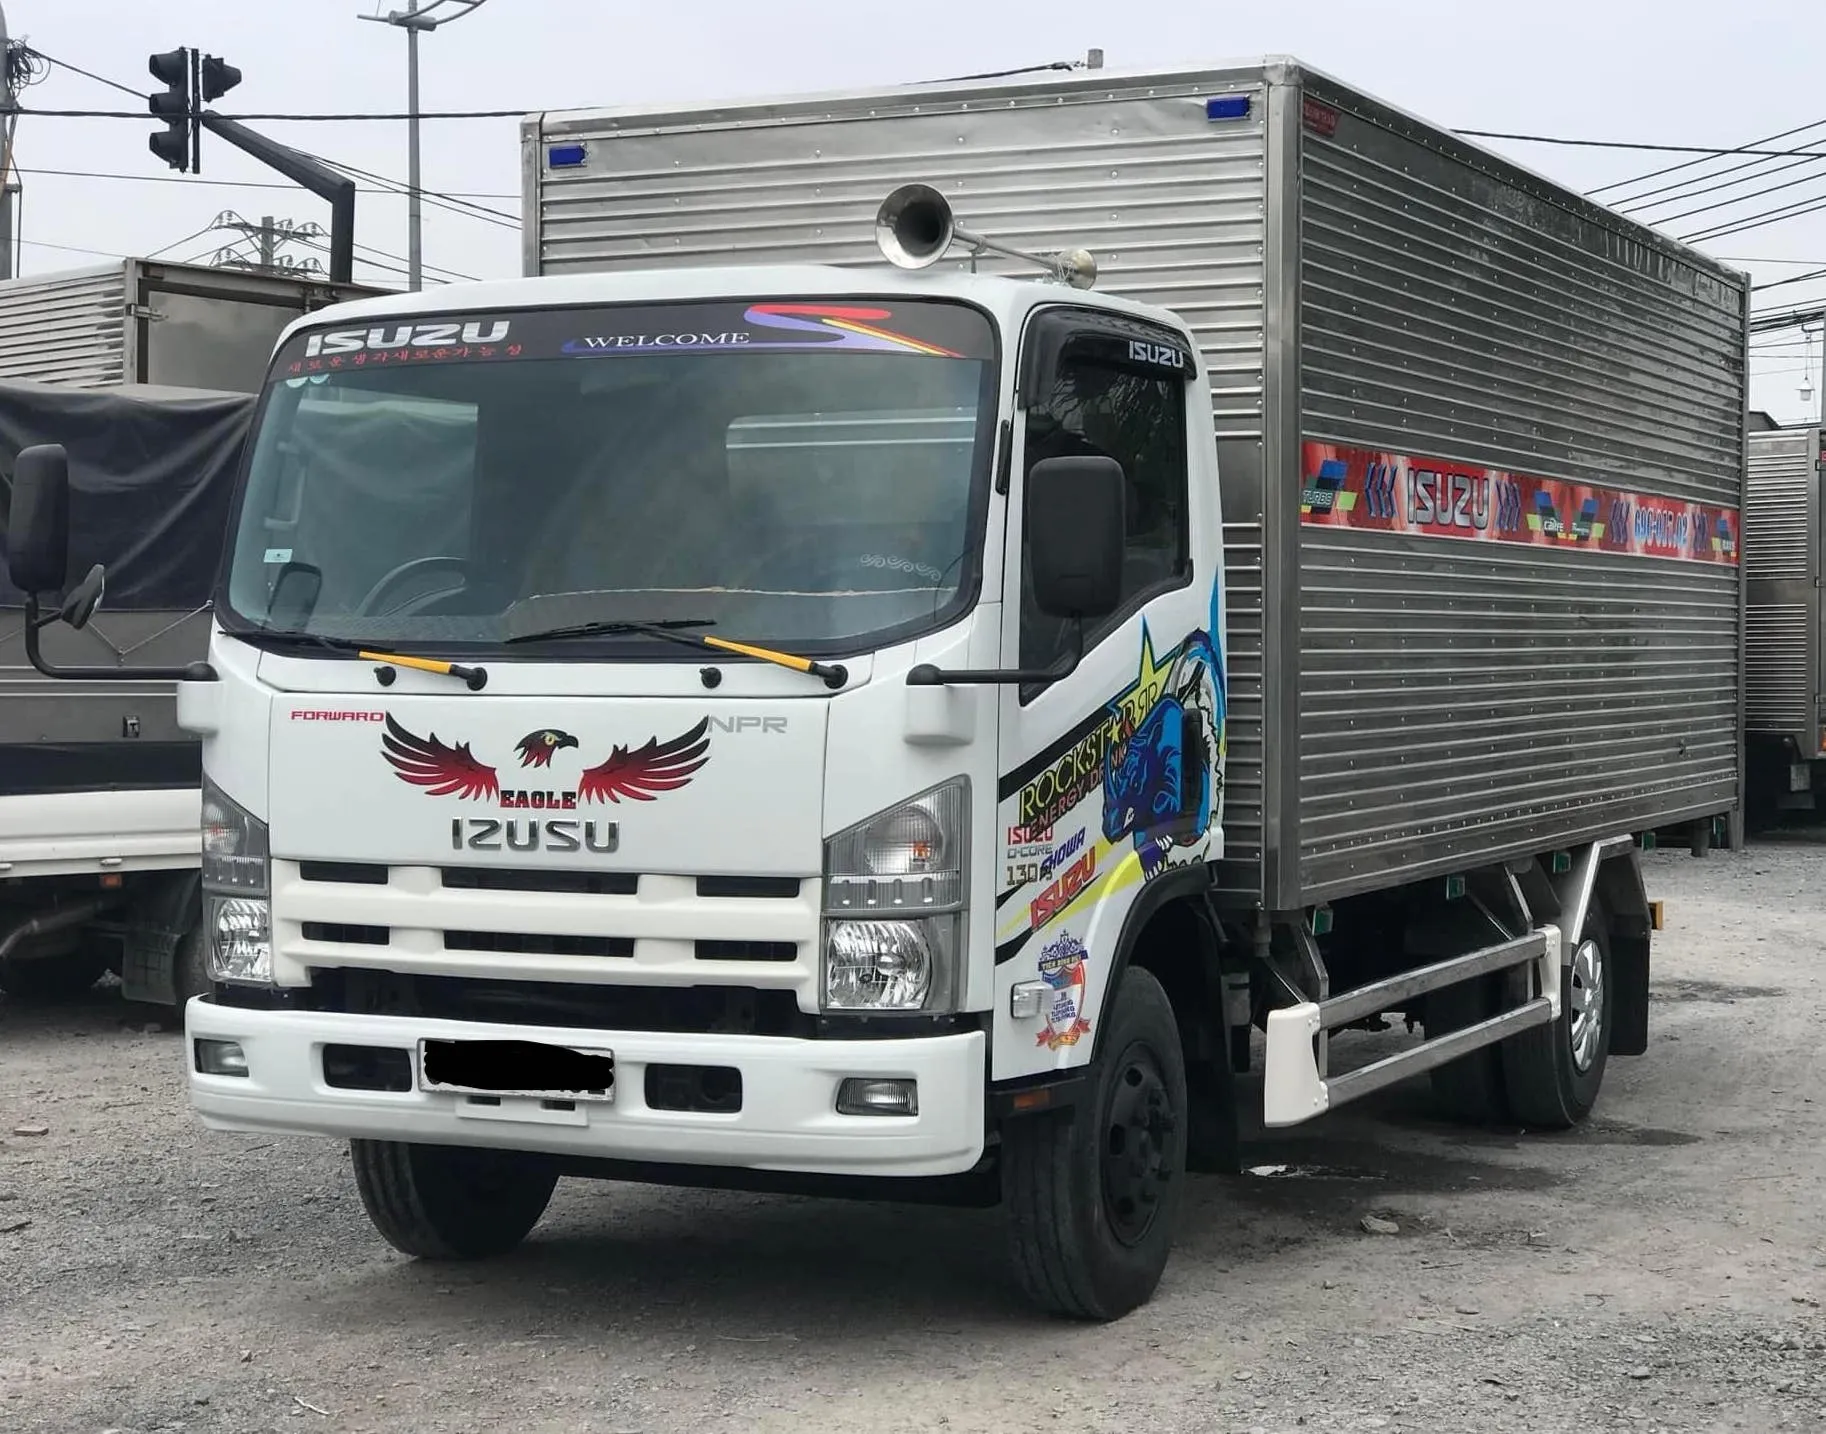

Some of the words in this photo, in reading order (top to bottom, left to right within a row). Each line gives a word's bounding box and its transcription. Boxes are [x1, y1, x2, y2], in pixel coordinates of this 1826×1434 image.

[305, 320, 510, 357] ISUZU
[584, 332, 750, 349] WELCOME
[1128, 340, 1184, 368] ISUZU
[1407, 467, 1490, 530] ISUZU
[291, 710, 385, 723] FORWARD
[707, 715, 788, 734] NPR
[500, 789, 576, 809] EAGLE
[451, 816, 620, 853] IZUSU
[1030, 846, 1096, 930] ISUZU
